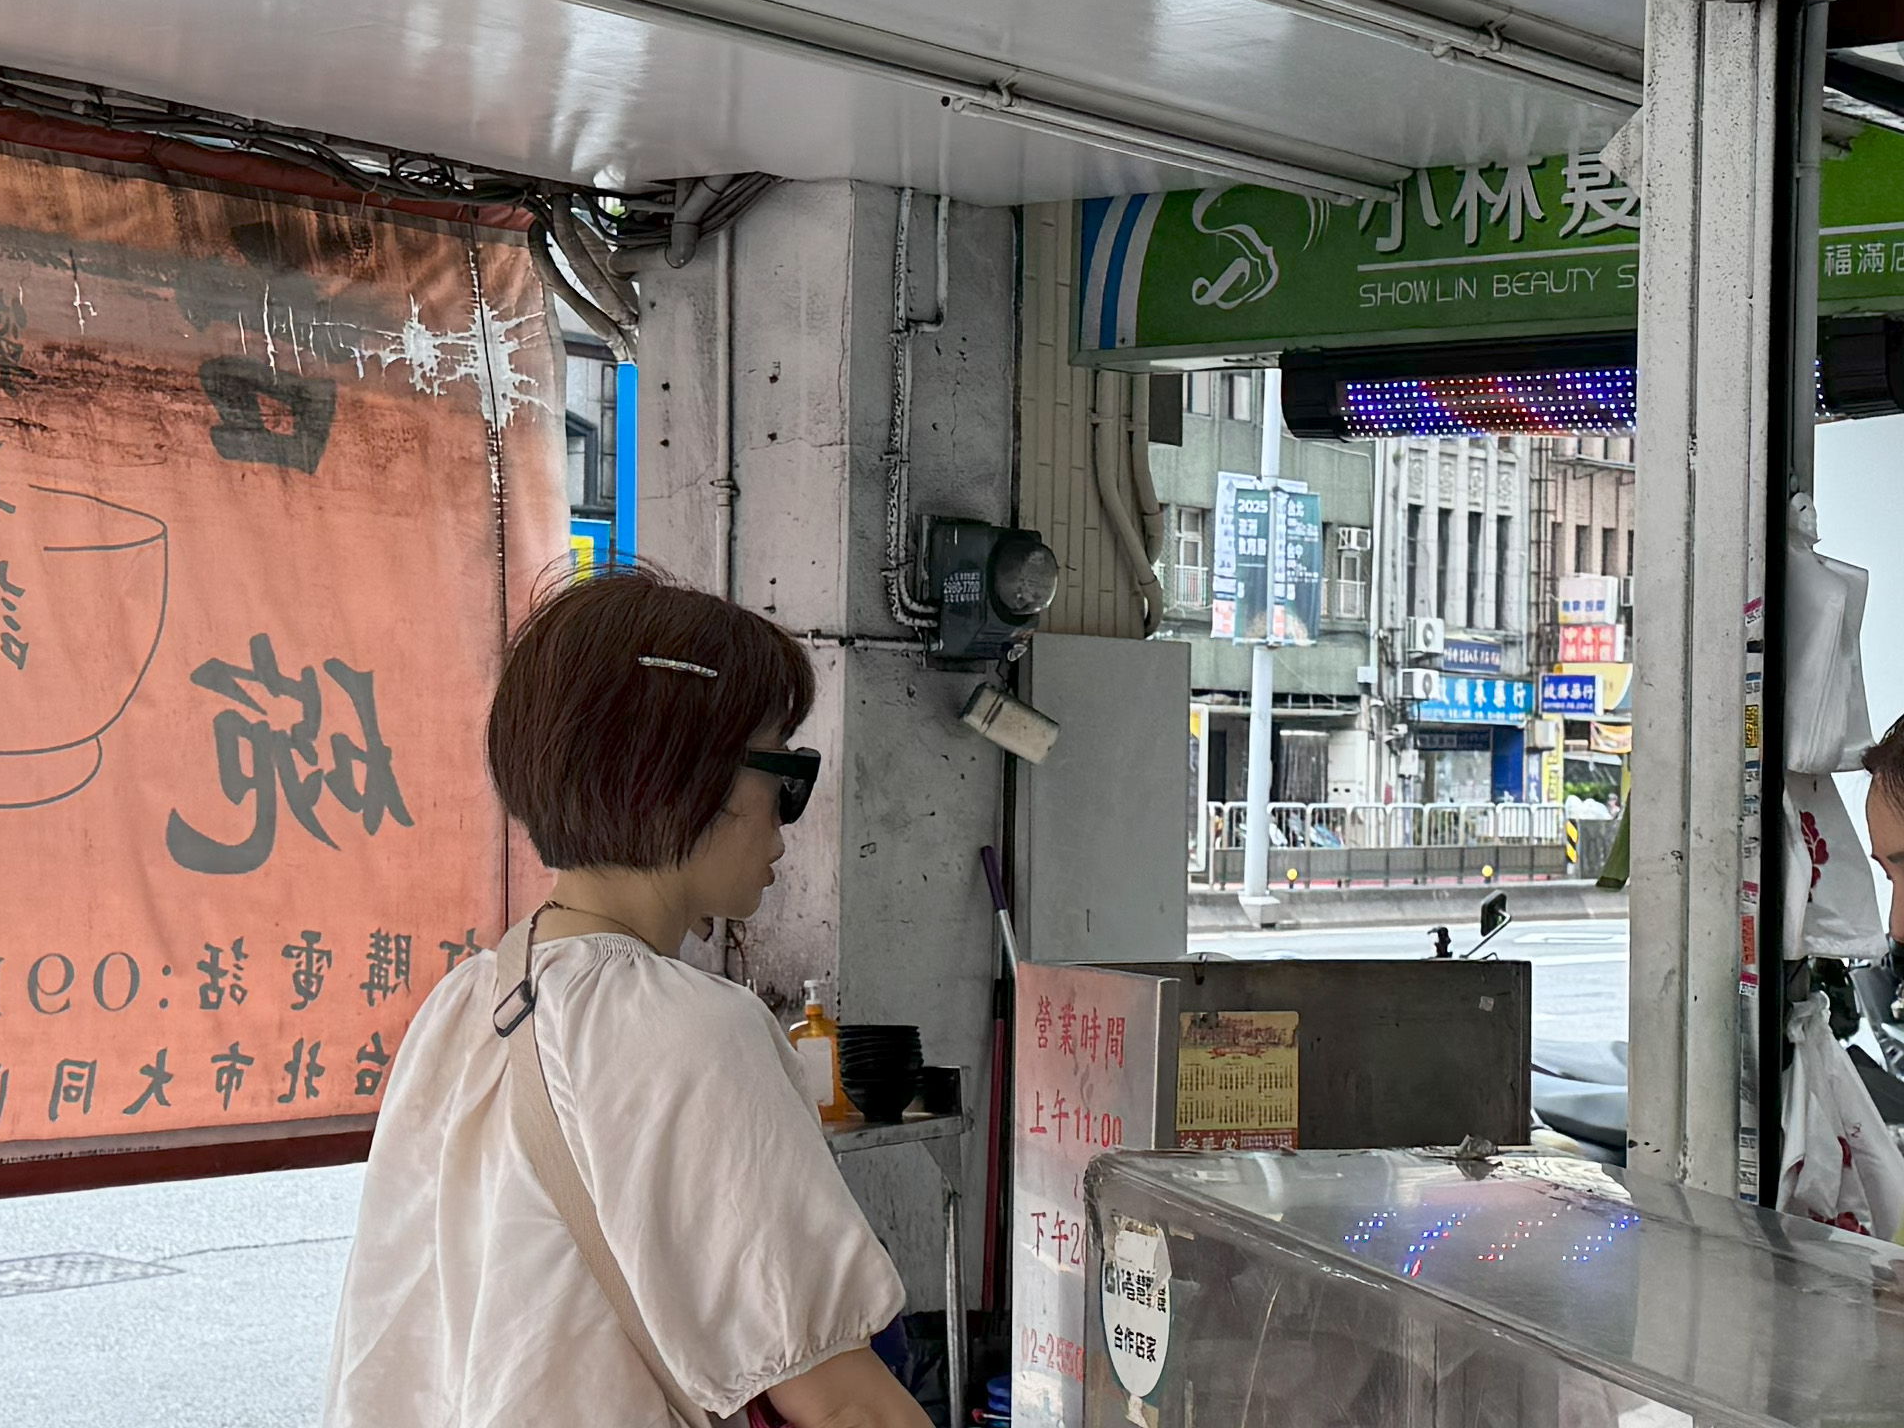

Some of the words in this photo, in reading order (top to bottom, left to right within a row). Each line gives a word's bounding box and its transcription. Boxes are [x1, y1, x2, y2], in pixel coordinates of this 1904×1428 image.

[1493, 266, 1601, 298] BEAUTY
[1237, 499, 1269, 514] 2025
[1034, 994, 1126, 1070] 營業時間
[1029, 1089, 1123, 1148] 上午11:00
[1114, 1323, 1156, 1363] 合作店家
